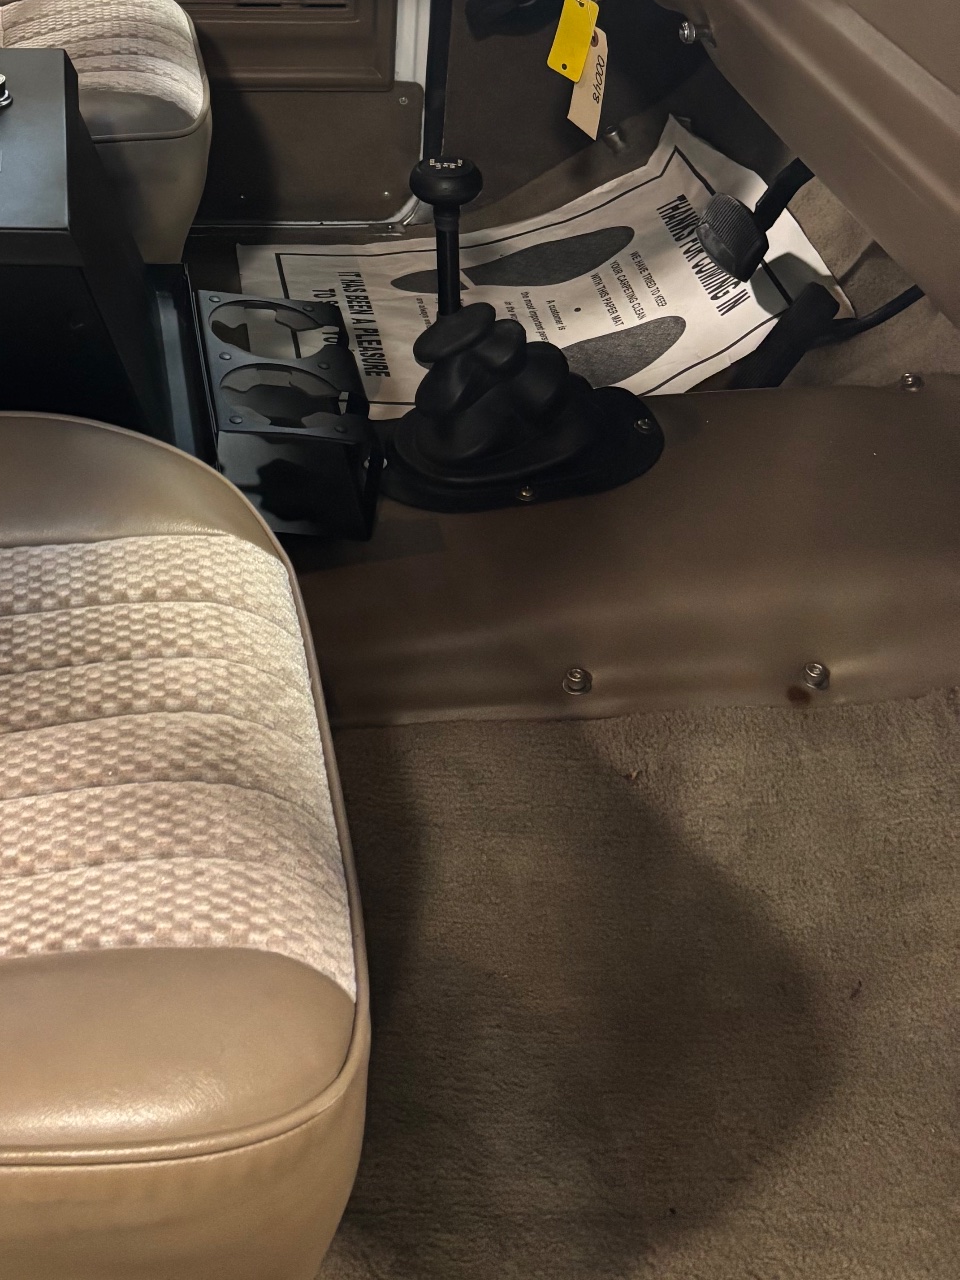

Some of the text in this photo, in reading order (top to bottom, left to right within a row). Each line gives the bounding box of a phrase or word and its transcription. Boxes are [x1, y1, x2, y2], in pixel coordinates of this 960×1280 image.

[592, 54, 605, 104] 00048
[656, 194, 699, 242] THANKS
[716, 288, 751, 317] IN
[312, 288, 336, 299] TO
[340, 279, 367, 293] HAS
[610, 260, 647, 321] YOUR CARPETING CLEAN
[630, 251, 668, 307] WE HAVE TRIED TO KEEP
[345, 294, 374, 315] BEEN
[524, 299, 536, 310] most
[548, 305, 564, 325] customer
[590, 272, 625, 327] WITH THIS PAPER MAT
[351, 317, 376, 325] A
[353, 327, 391, 378] PLEASURE
